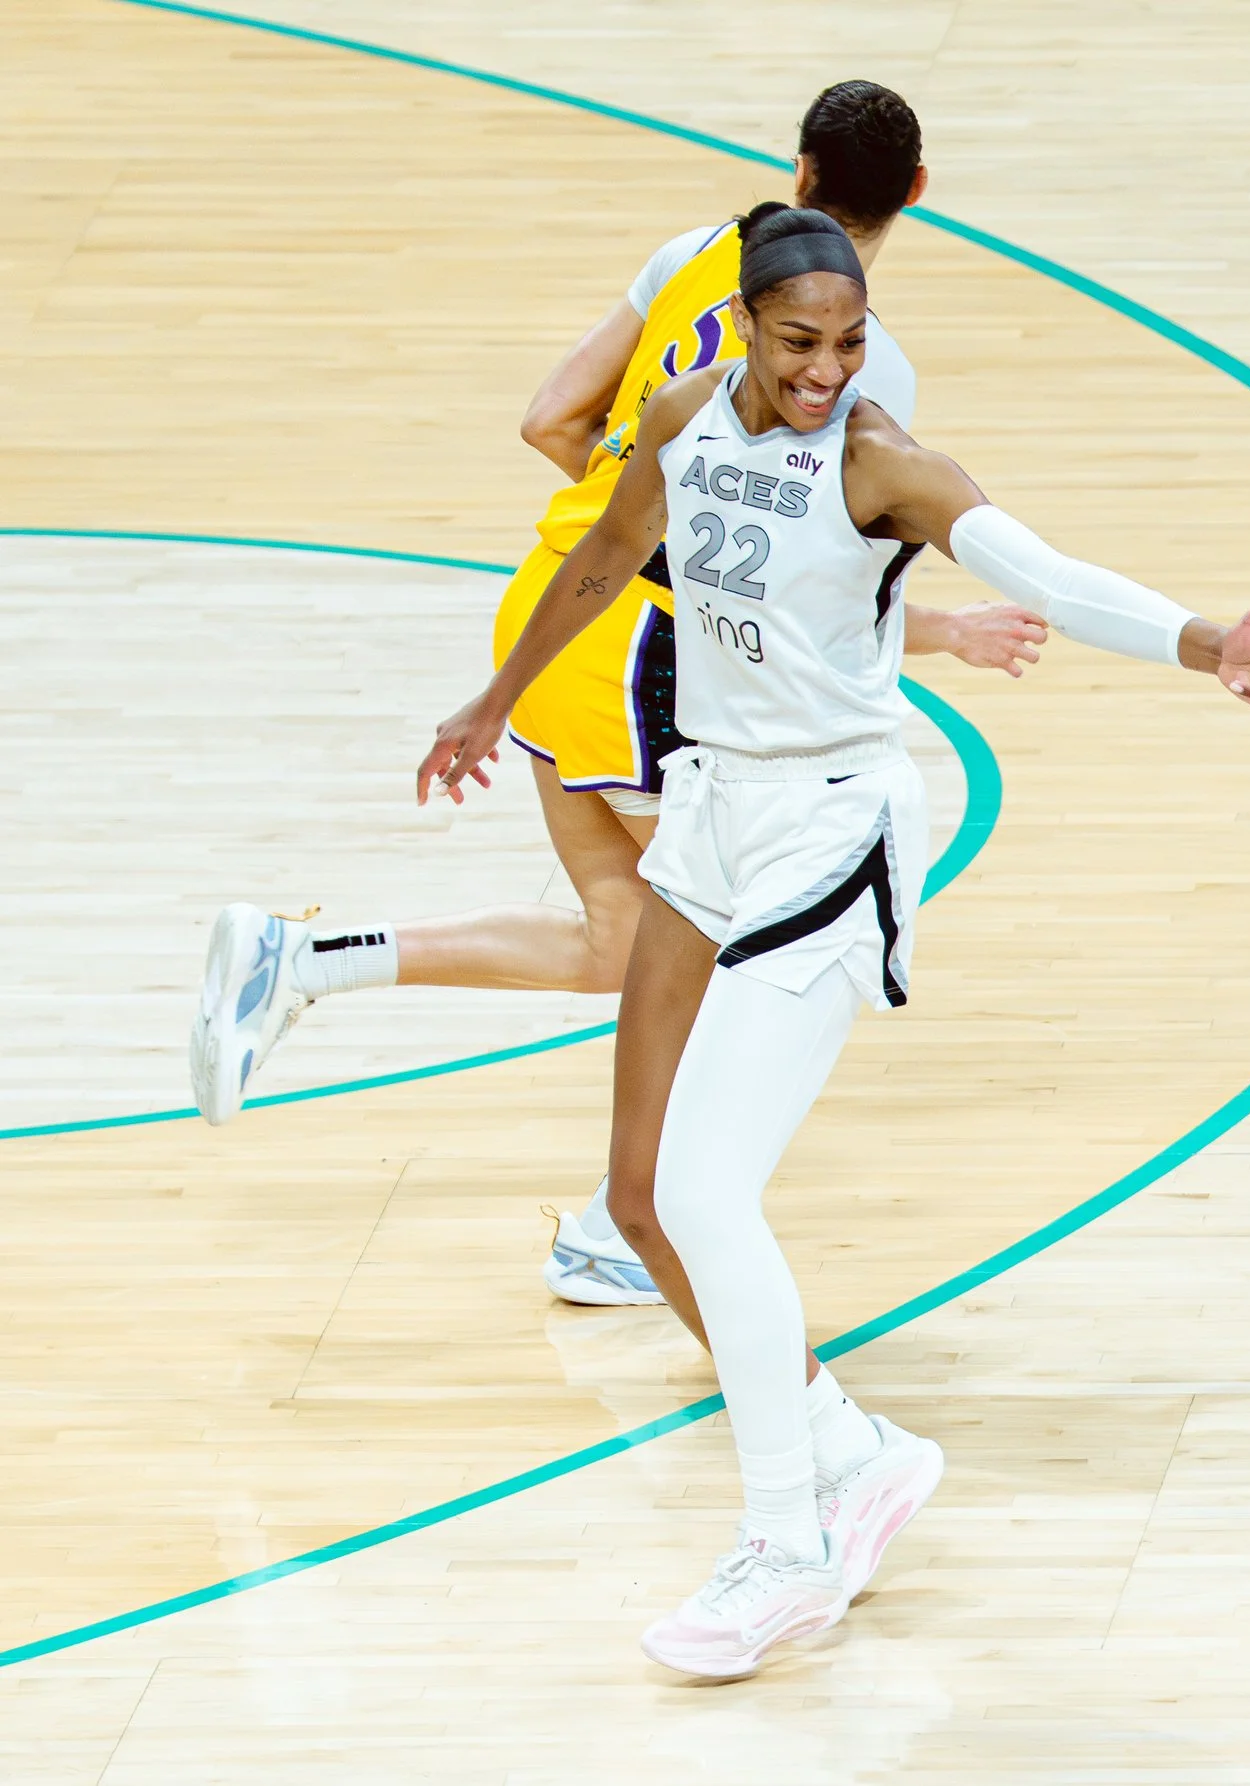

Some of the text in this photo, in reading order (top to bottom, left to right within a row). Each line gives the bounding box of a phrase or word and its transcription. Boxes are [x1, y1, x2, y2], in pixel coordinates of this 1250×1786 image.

[679, 455, 813, 518] ACES
[786, 451, 824, 477] ally
[684, 511, 771, 601] 22
[697, 601, 764, 664] ring
